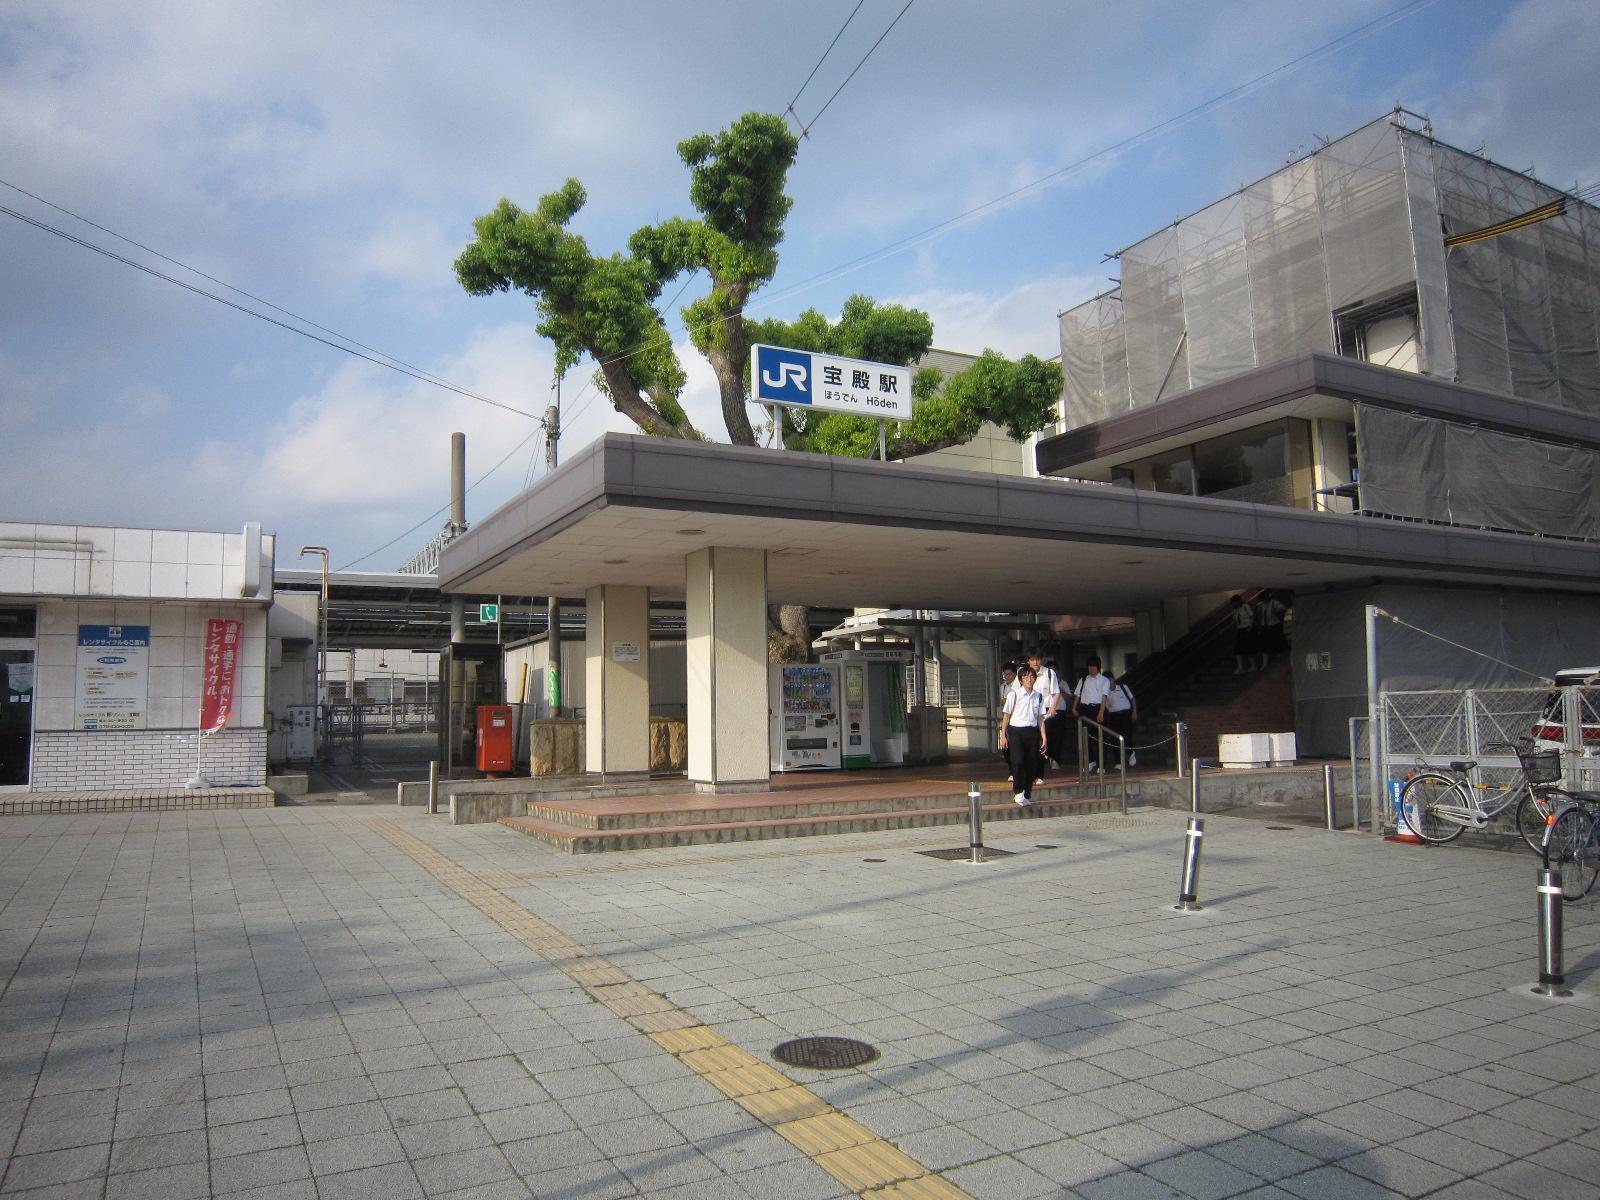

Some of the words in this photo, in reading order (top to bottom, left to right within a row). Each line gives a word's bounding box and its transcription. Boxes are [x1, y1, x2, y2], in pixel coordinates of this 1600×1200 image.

[763, 362, 807, 391] JR
[823, 365, 898, 394] 宝殿駅
[824, 390, 858, 404] ほうでん
[866, 396, 898, 409] Hōden
